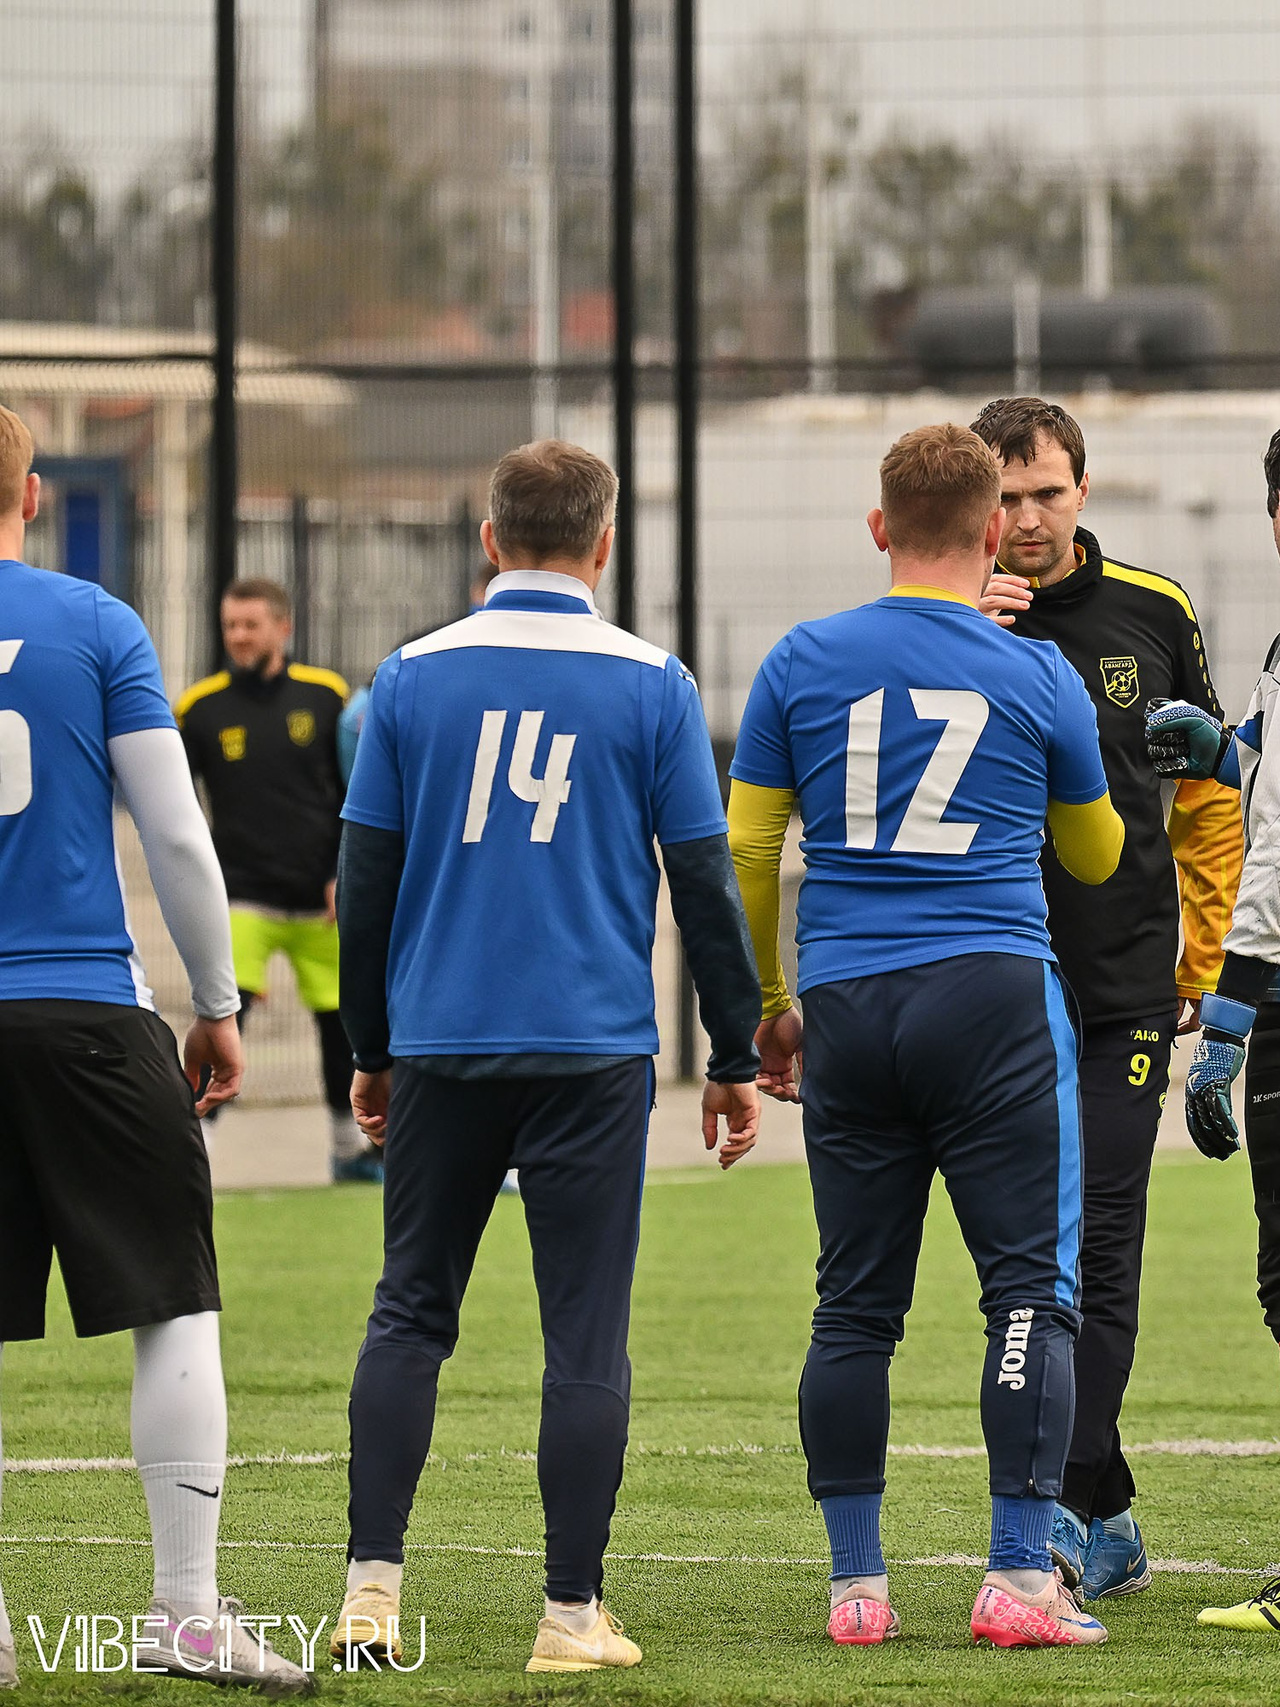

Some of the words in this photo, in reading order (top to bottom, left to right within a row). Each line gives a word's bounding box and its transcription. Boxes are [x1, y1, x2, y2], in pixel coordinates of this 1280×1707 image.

[463, 710, 577, 844] 14
[845, 688, 990, 855] 12
[1128, 1053, 1151, 1086] 9
[997, 1307, 1035, 1390] Joma
